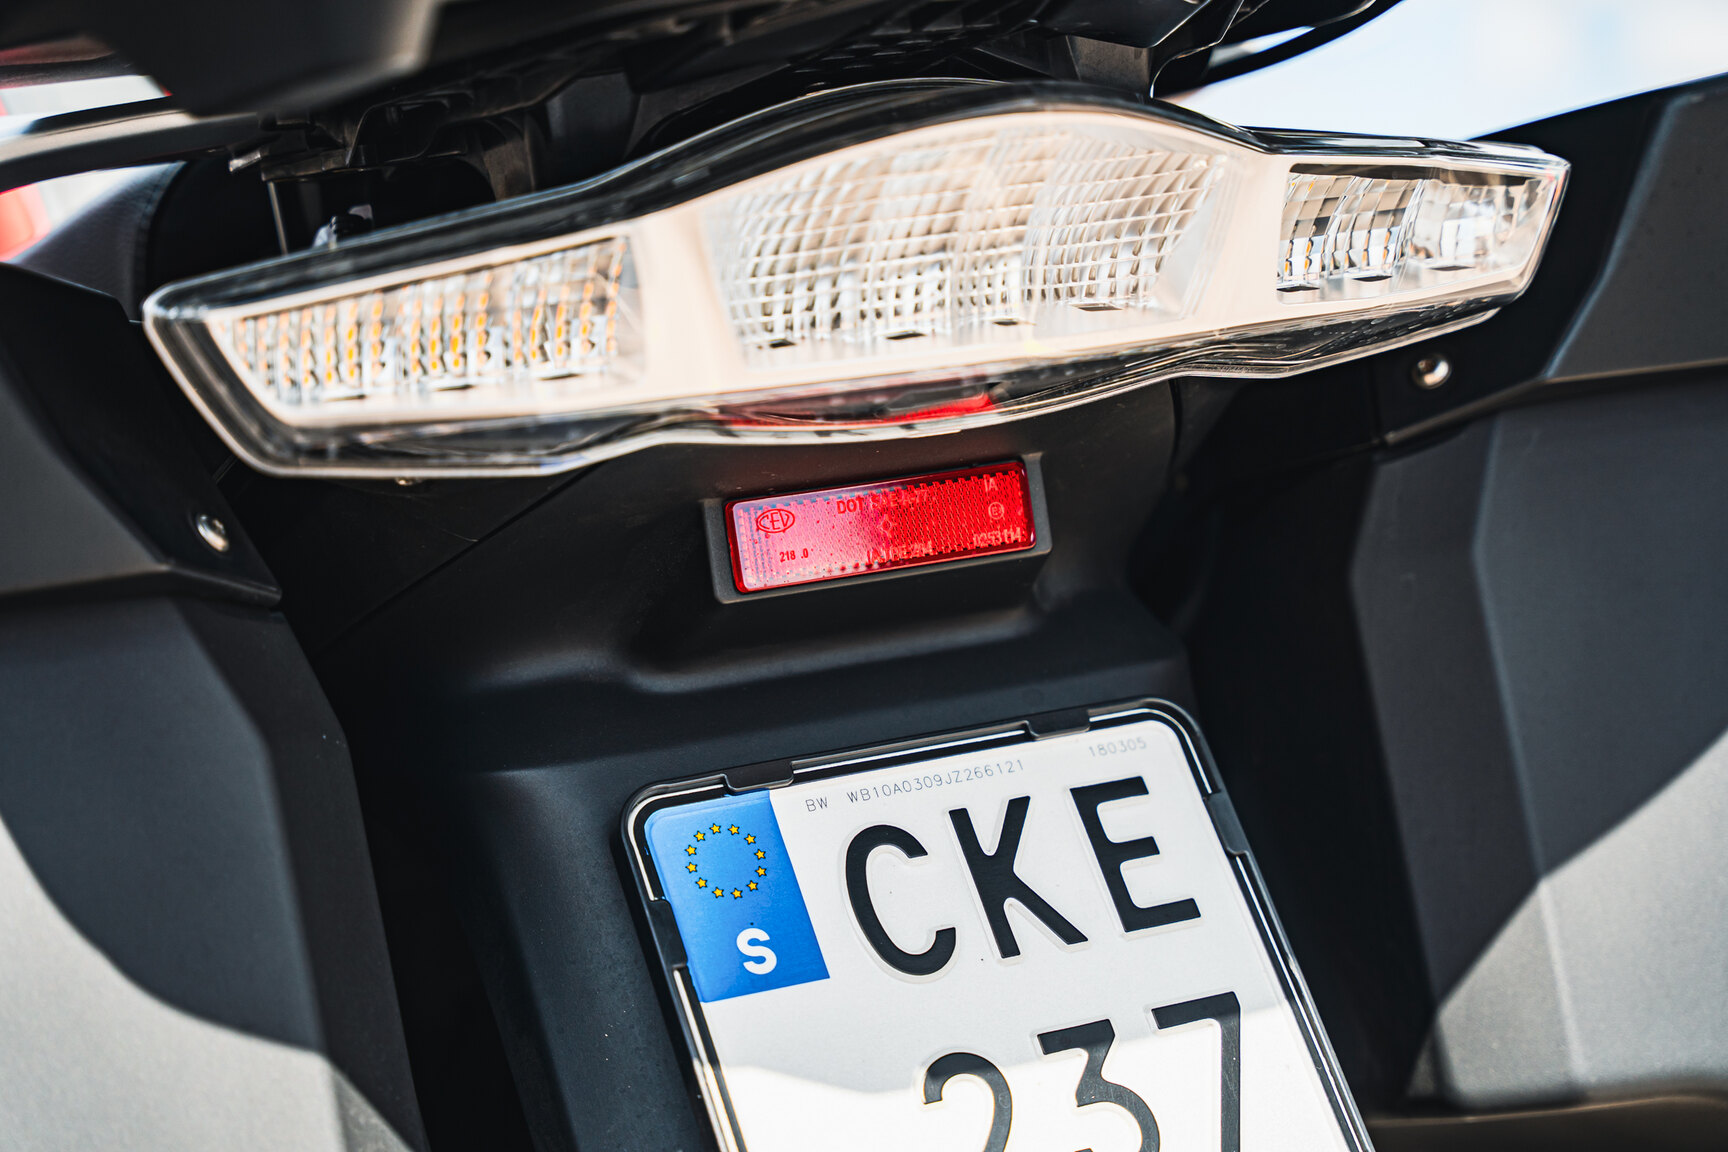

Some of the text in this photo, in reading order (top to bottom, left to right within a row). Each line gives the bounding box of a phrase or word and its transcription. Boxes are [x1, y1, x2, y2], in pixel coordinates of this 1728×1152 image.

[758, 511, 790, 531] CEV
[836, 496, 864, 514] DOT
[779, 550, 796, 562] 218
[805, 736, 1147, 813] BW WB10A0309JZ266121 180305
[844, 775, 1201, 976] CKE
[735, 927, 778, 975] S
[922, 990, 1242, 1152] 237
